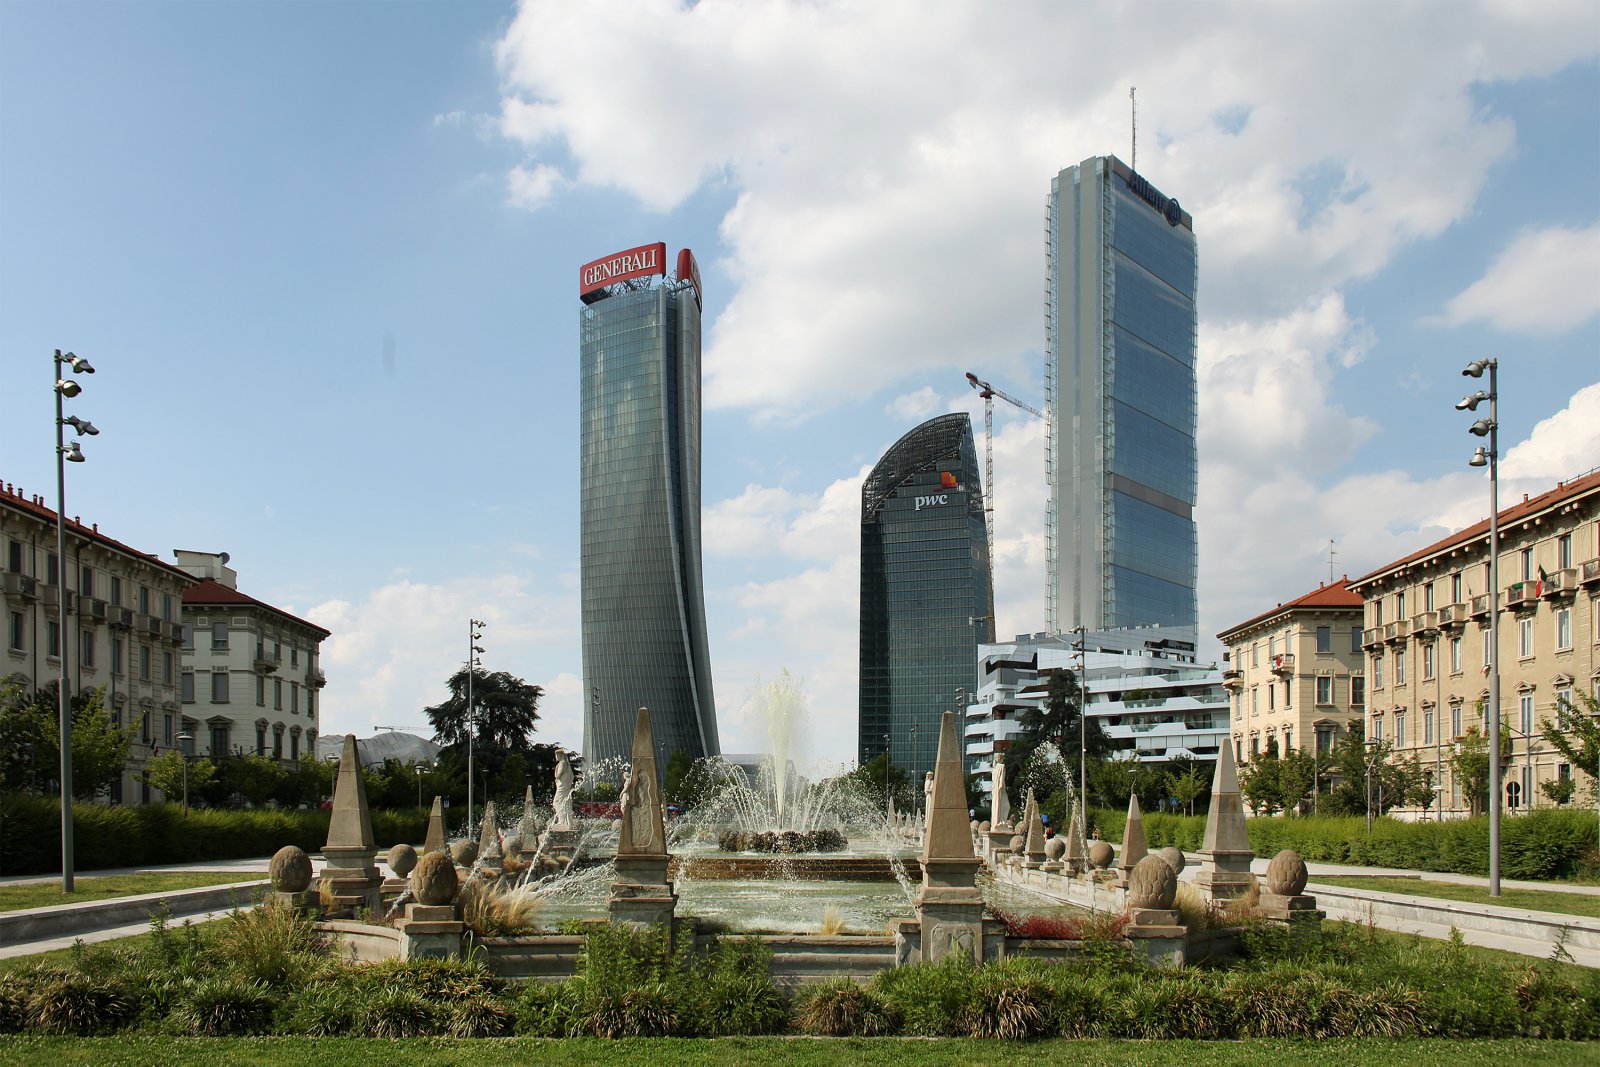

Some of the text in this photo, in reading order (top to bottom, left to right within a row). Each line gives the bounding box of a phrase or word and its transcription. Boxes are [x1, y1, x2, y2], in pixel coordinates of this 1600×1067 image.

[1130, 171, 1165, 212] Allian
[584, 249, 657, 287] GENERALI
[914, 494, 948, 511] pwc
